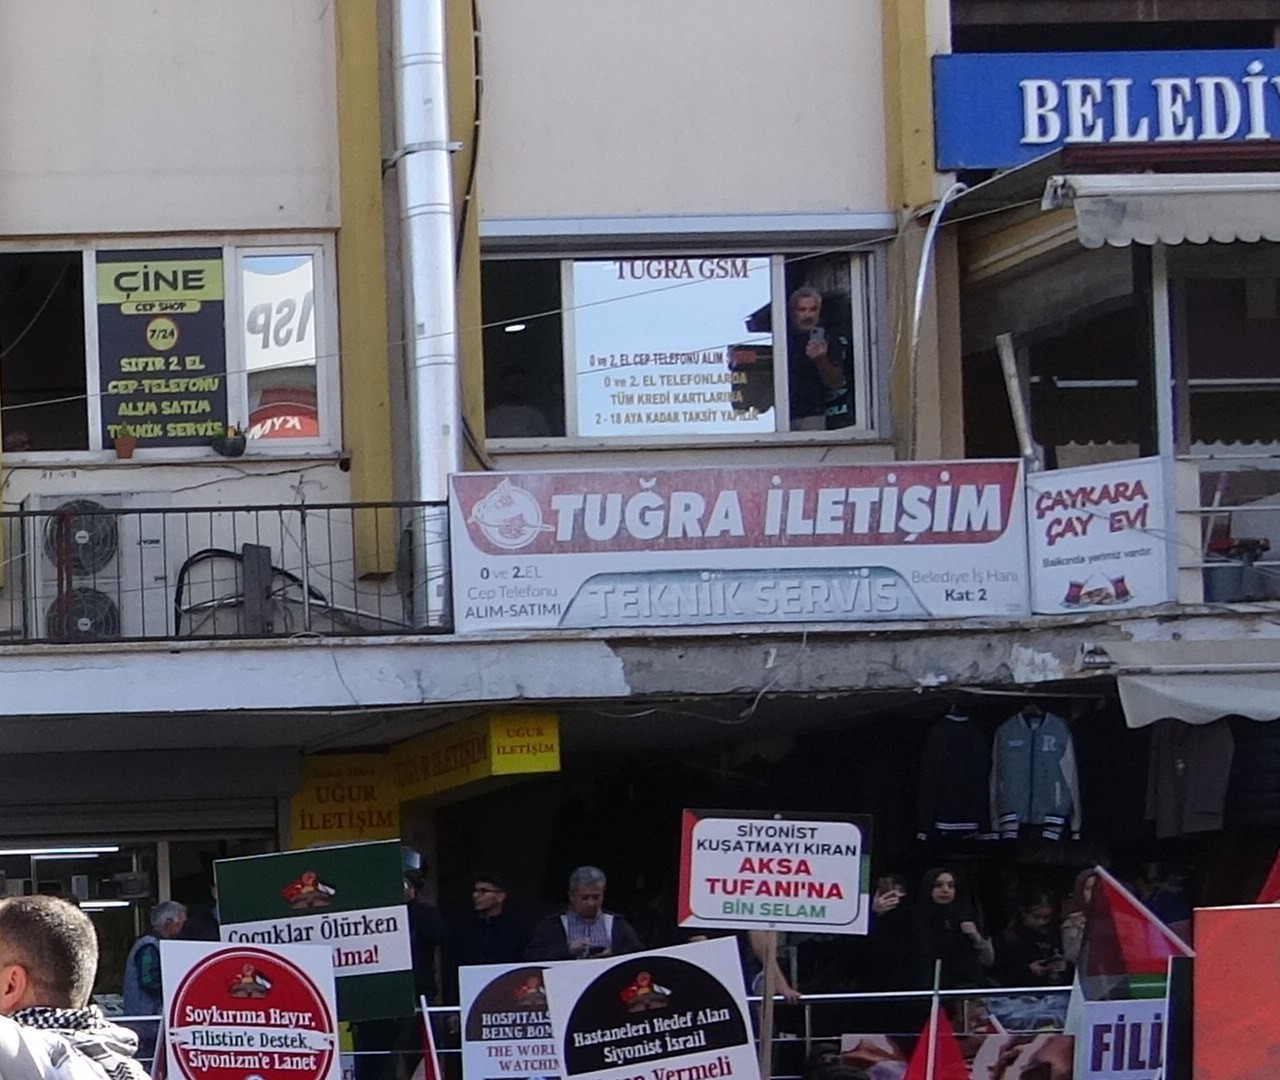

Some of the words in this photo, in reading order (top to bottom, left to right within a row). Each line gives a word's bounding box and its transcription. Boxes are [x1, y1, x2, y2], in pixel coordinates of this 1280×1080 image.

[1019, 60, 1279, 144] BELEDİ
[699, 258, 750, 279] GSM
[114, 265, 205, 299] ÇİNE
[135, 302, 156, 312] CEP
[149, 329, 176, 341] 7/24
[185, 355, 205, 370] EL
[643, 375, 656, 387] EL
[118, 401, 158, 415] ALIM
[162, 400, 211, 414] SATIM
[611, 391, 634, 406] TÜM
[637, 390, 671, 405] KREDİ
[646, 411, 680, 423] KADAR
[552, 477, 744, 542] TUĞRA
[766, 470, 1001, 542] İLETİŞİM
[1036, 479, 1148, 520] ÇAYKARA
[1045, 513, 1092, 547] ÇAY
[1109, 502, 1148, 534] EVİ
[480, 567, 489, 580] 0
[912, 569, 969, 585] Belediye
[987, 569, 1018, 583] Hanı
[467, 586, 495, 602] Cep
[498, 584, 558, 599] Telefonu
[590, 572, 743, 619] TEKNİK
[755, 567, 899, 617] SERVİS
[978, 588, 988, 602] 2
[465, 603, 561, 620] ALIM-SATIMI
[300, 807, 395, 834] İLETİŞİM
[737, 823, 819, 840] SİYONİST
[696, 838, 800, 855] KUŞATMAYI
[804, 843, 858, 857] KIRAN
[739, 857, 812, 876] AKSA
[705, 877, 843, 900] TUFANI'NA
[722, 899, 754, 916] BİN
[759, 902, 827, 919] SELAM
[320, 914, 398, 940] Ölürken
[186, 1005, 265, 1026] Soykırıma
[482, 1026, 523, 1040] BEING
[573, 1022, 651, 1047] Hastaneleri
[653, 1013, 694, 1034] Hedef
[697, 1007, 730, 1024] Alan
[192, 1030, 255, 1047] Filistin'e
[603, 1040, 663, 1064] Siyonist
[666, 1030, 706, 1051] İsrail
[486, 1045, 513, 1058] THE
[189, 1052, 271, 1073] Siyonizm'e
[274, 1053, 317, 1070] Lanet
